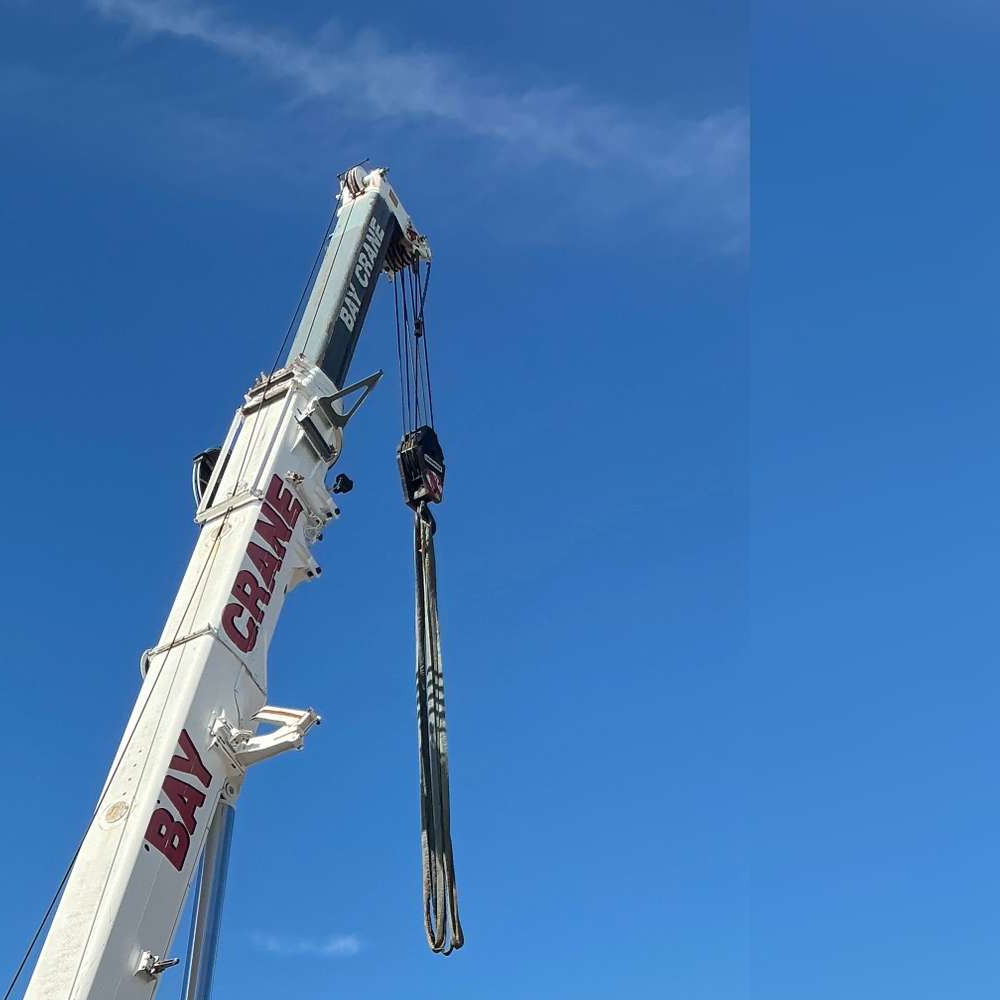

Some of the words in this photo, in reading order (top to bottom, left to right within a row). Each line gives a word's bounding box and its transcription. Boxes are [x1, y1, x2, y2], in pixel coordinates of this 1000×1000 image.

[340, 282, 361, 332] BAY
[355, 216, 385, 288] CRANE
[144, 729, 213, 871] BAY
[221, 473, 304, 653] CRANE
